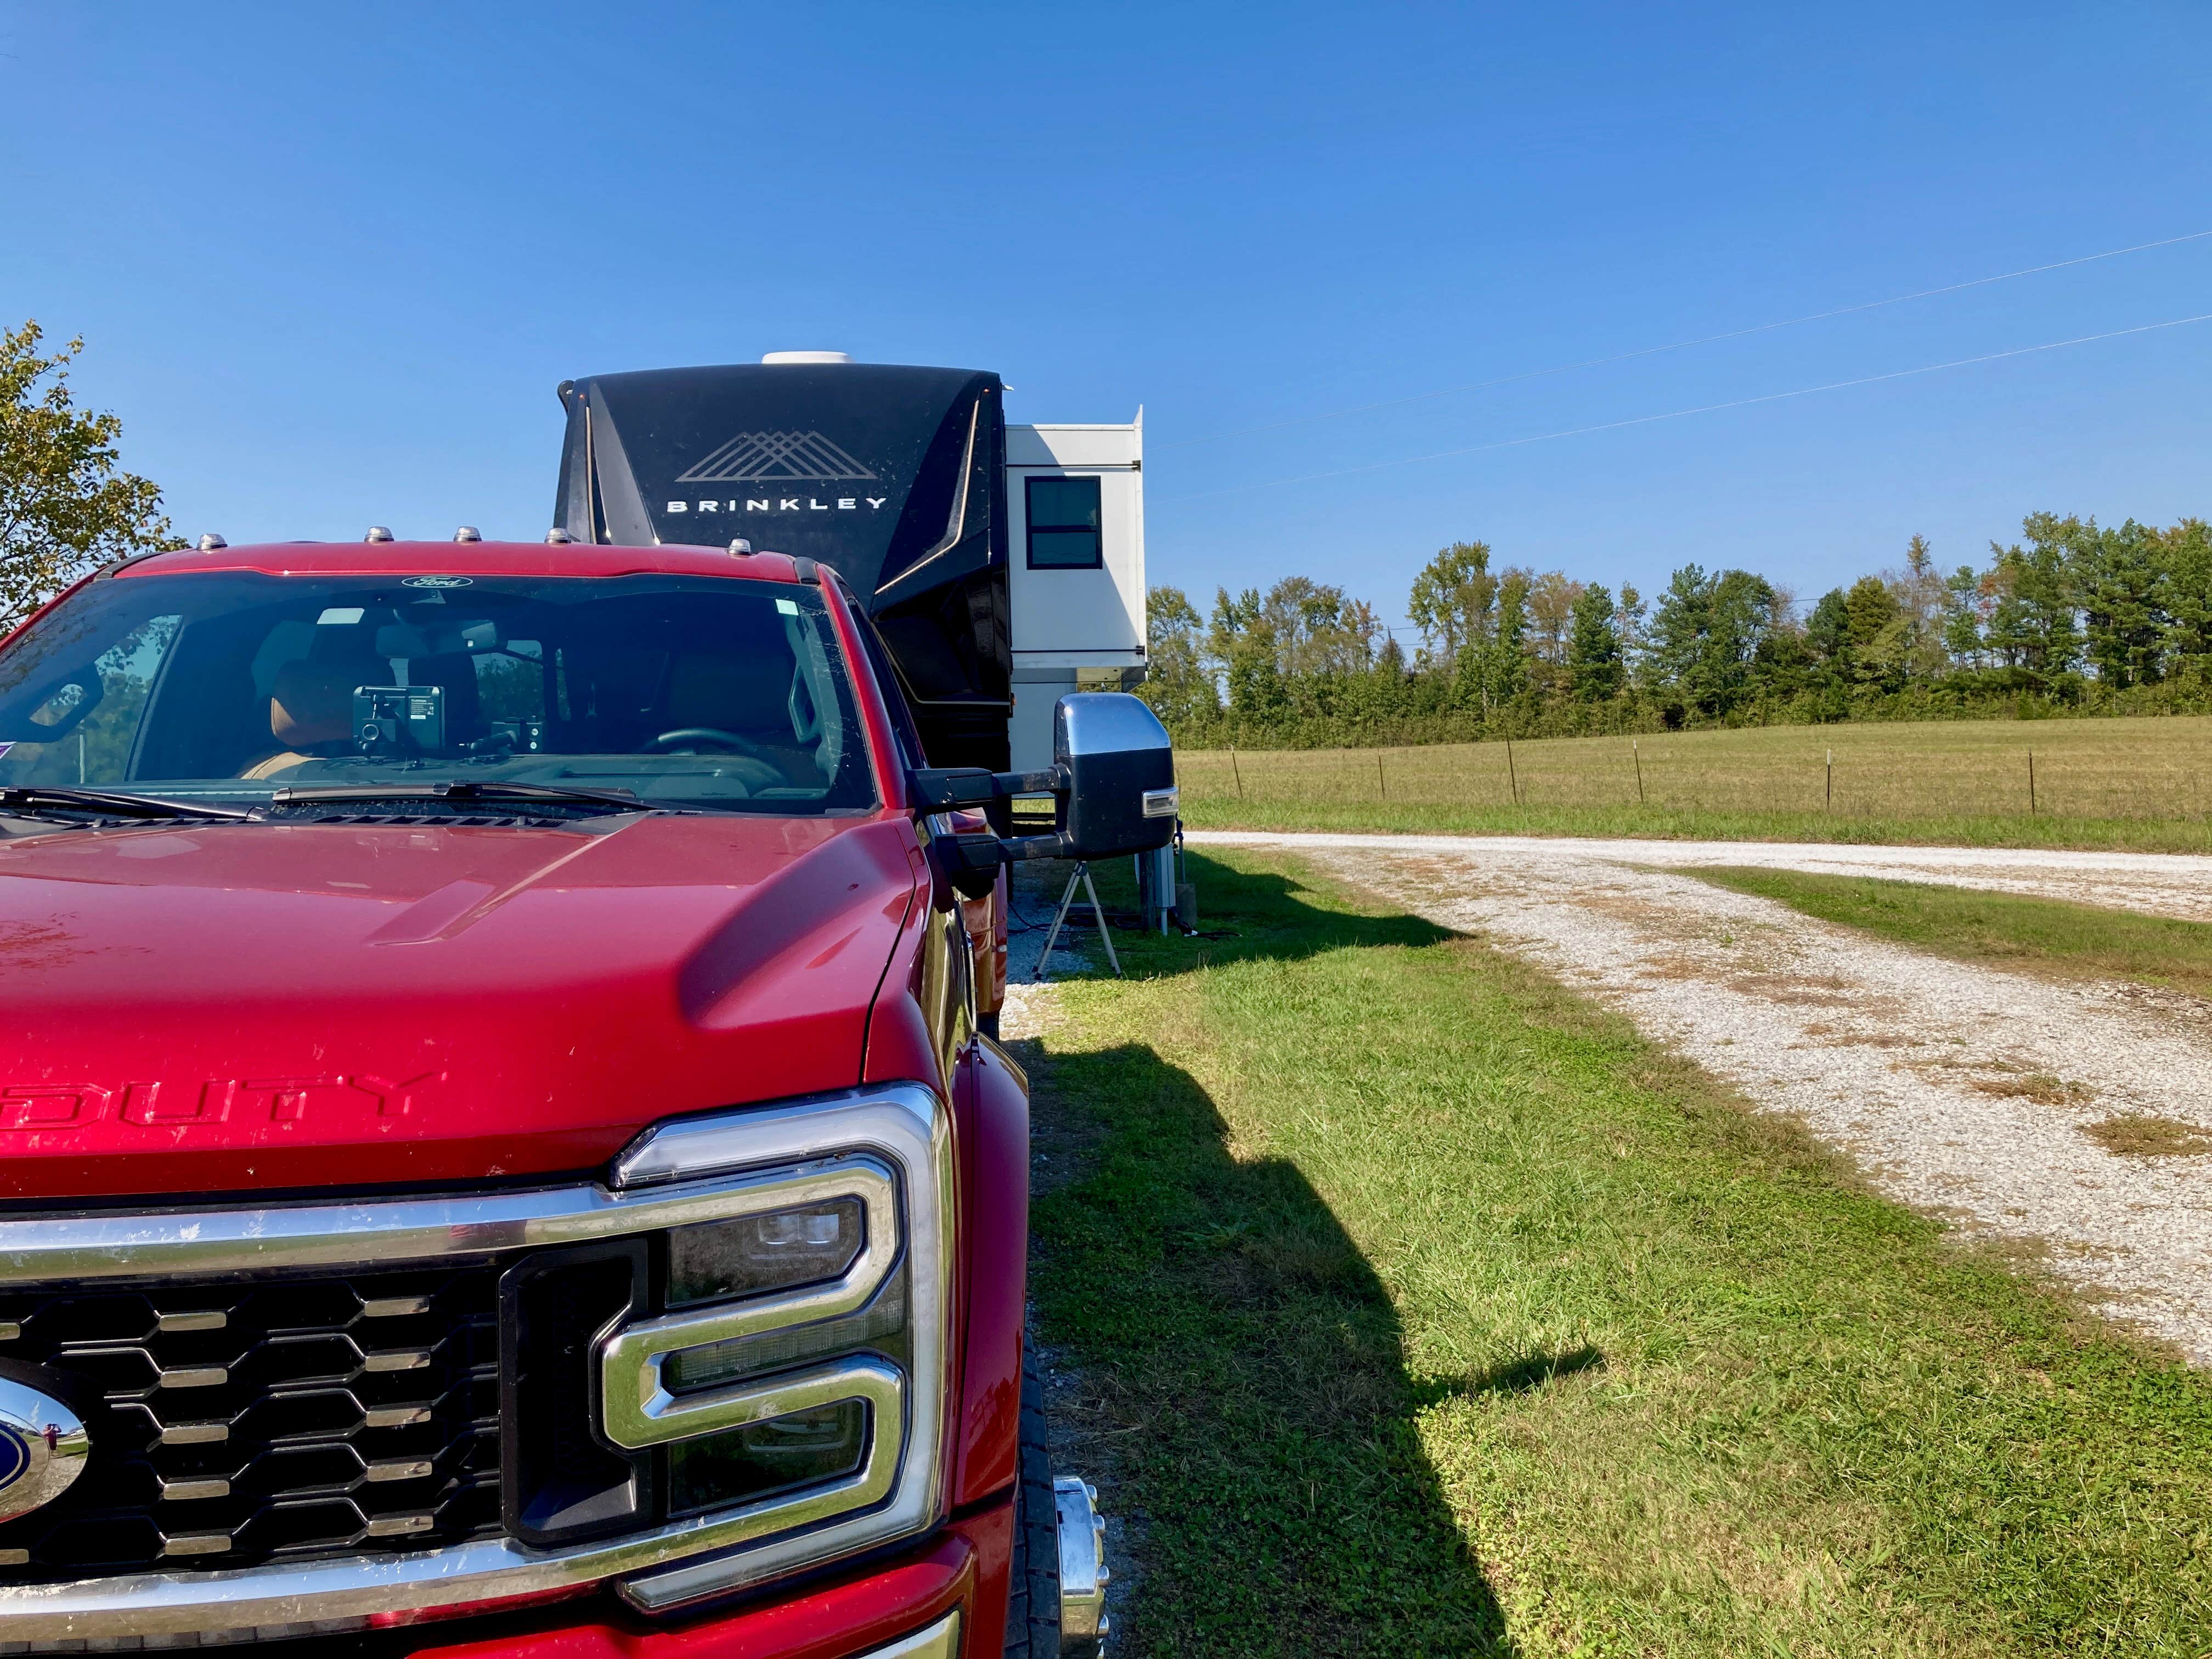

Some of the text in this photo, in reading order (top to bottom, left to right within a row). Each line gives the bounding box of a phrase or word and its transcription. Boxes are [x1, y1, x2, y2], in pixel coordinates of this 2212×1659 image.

[667, 498, 887, 512] BRINKLEY
[413, 577, 461, 586] Ford
[0, 1071, 448, 1132] DUTY
